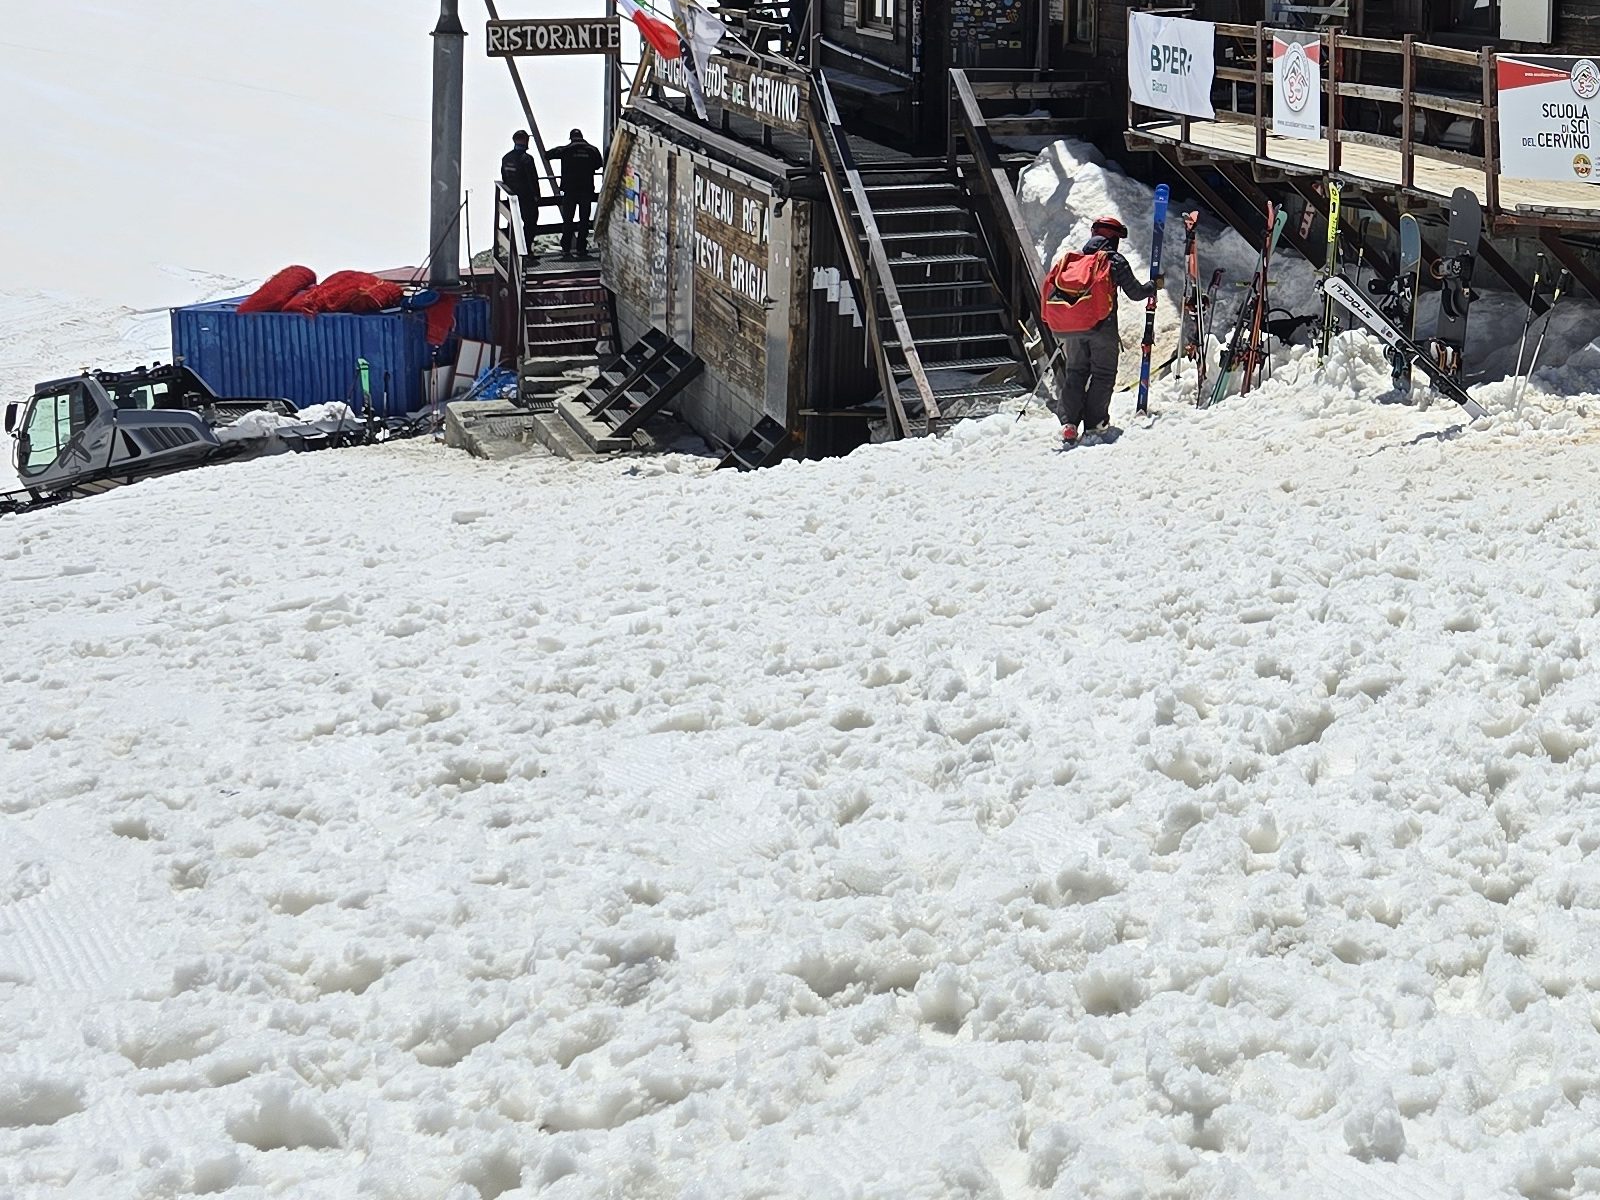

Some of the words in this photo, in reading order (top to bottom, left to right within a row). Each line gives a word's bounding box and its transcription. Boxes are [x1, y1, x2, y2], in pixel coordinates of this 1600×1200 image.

[488, 23, 620, 51] RISTORANTE
[732, 81, 746, 107] DEL
[749, 73, 799, 123] CERVINO
[1542, 103, 1590, 120] SCUOLA
[1562, 124, 1569, 134] DI
[1570, 119, 1589, 135] SCI
[1522, 137, 1536, 147] DEL
[1537, 133, 1591, 150] CERVINO
[695, 174, 734, 226] PLATEAU
[742, 197, 770, 245] ROA
[695, 230, 724, 281] TESTA
[730, 253, 769, 305] GRIGIA
